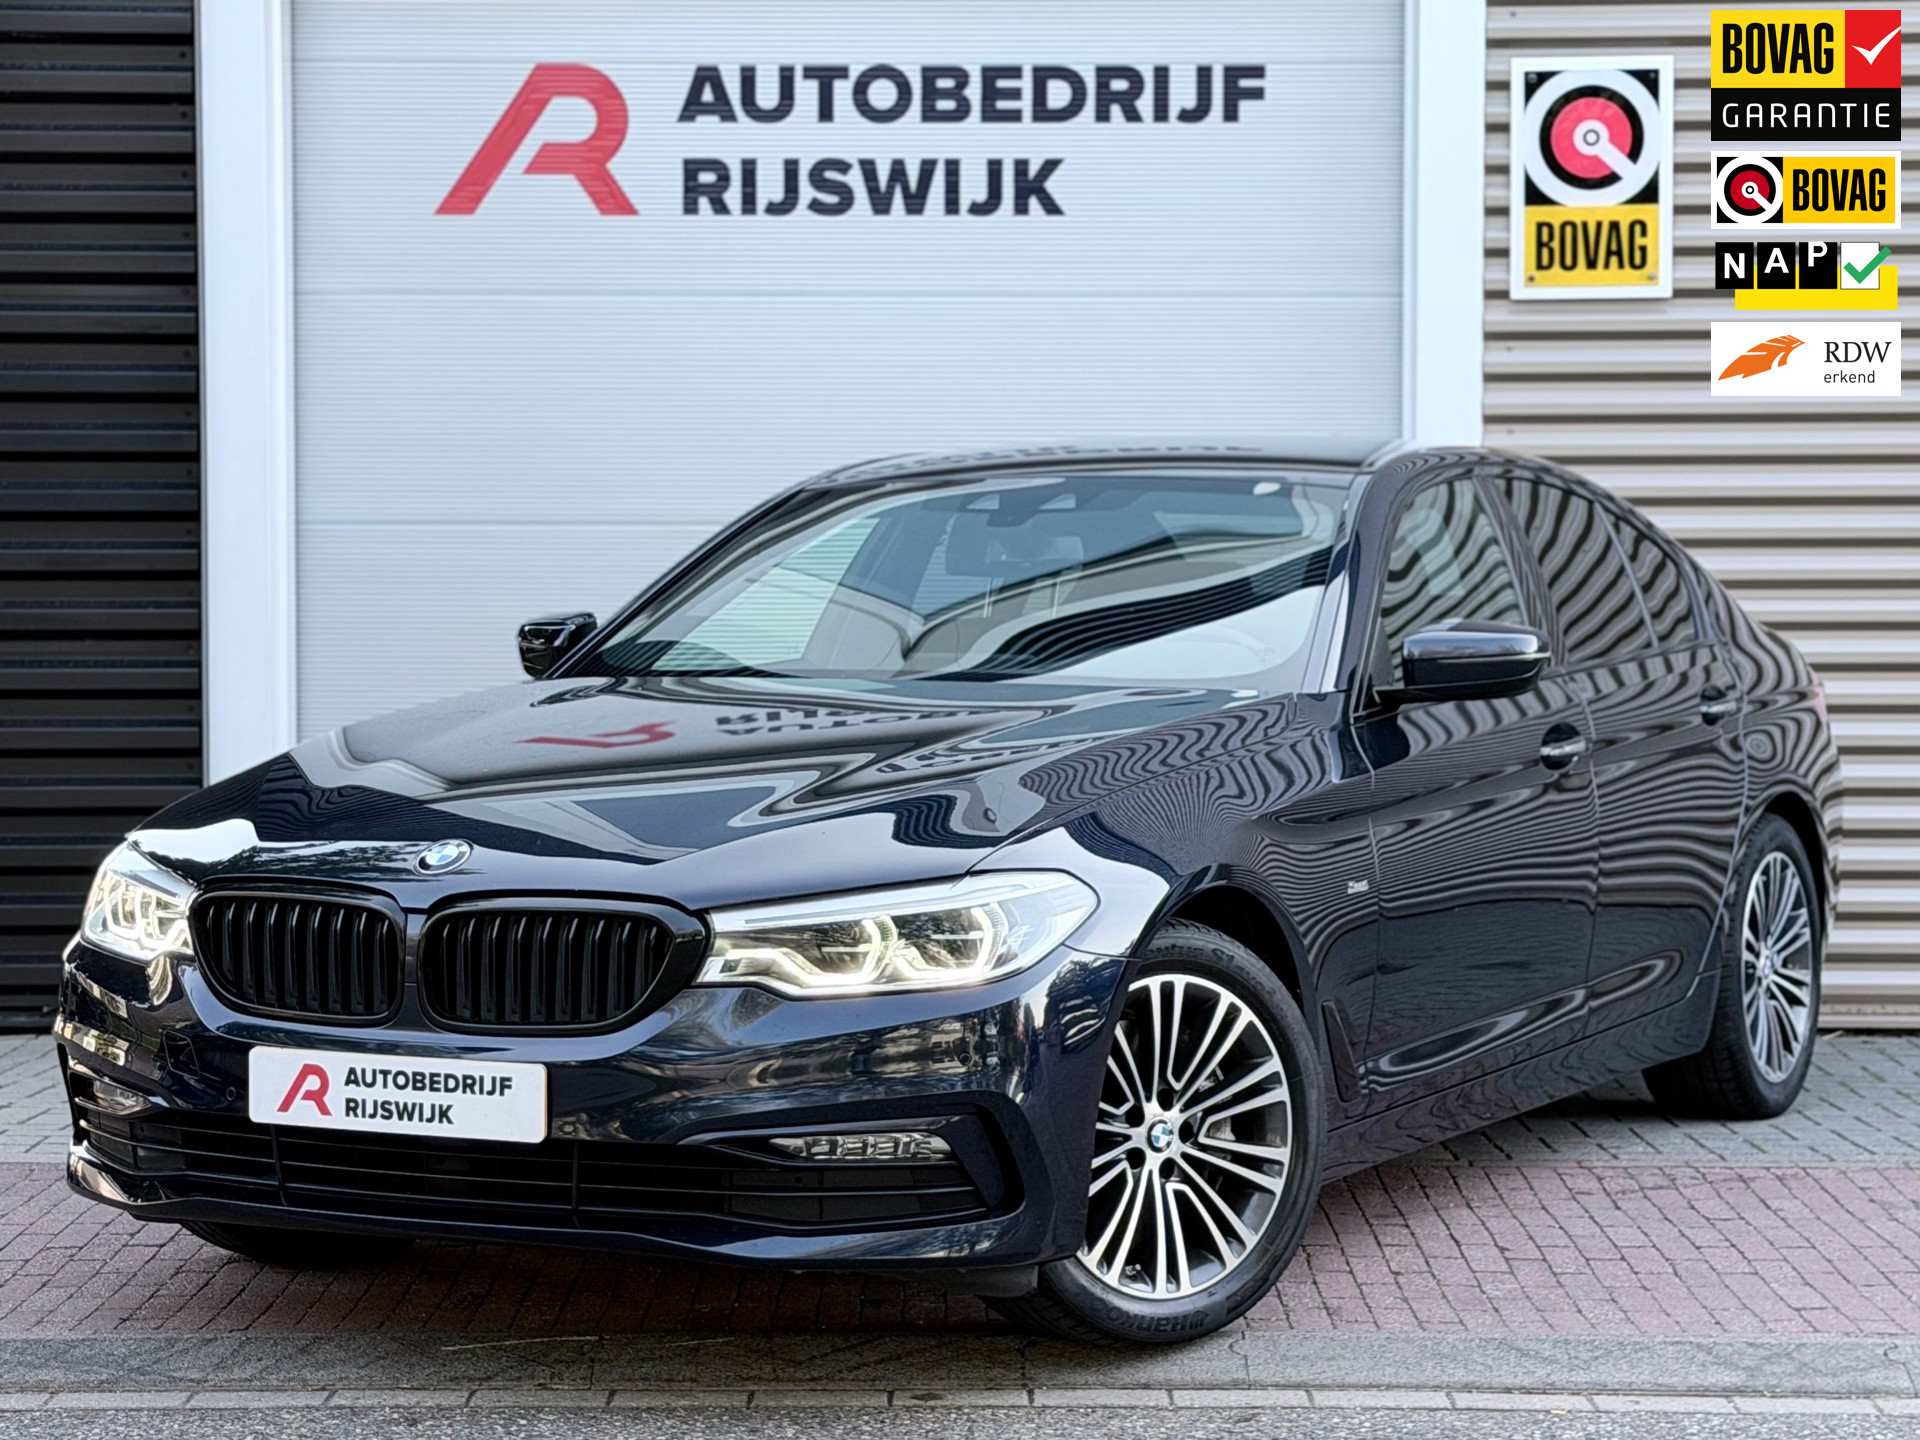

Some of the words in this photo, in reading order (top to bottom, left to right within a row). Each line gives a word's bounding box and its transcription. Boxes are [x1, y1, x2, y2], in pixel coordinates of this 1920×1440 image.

[677, 64, 1266, 124] AUTOBEDRIJF
[682, 158, 1065, 217] RIJSWIJK
[1535, 219, 1648, 272] BOVAG
[344, 1067, 513, 1097] AUTOBEDRIJF
[344, 1097, 454, 1125] RIJSWIJK
